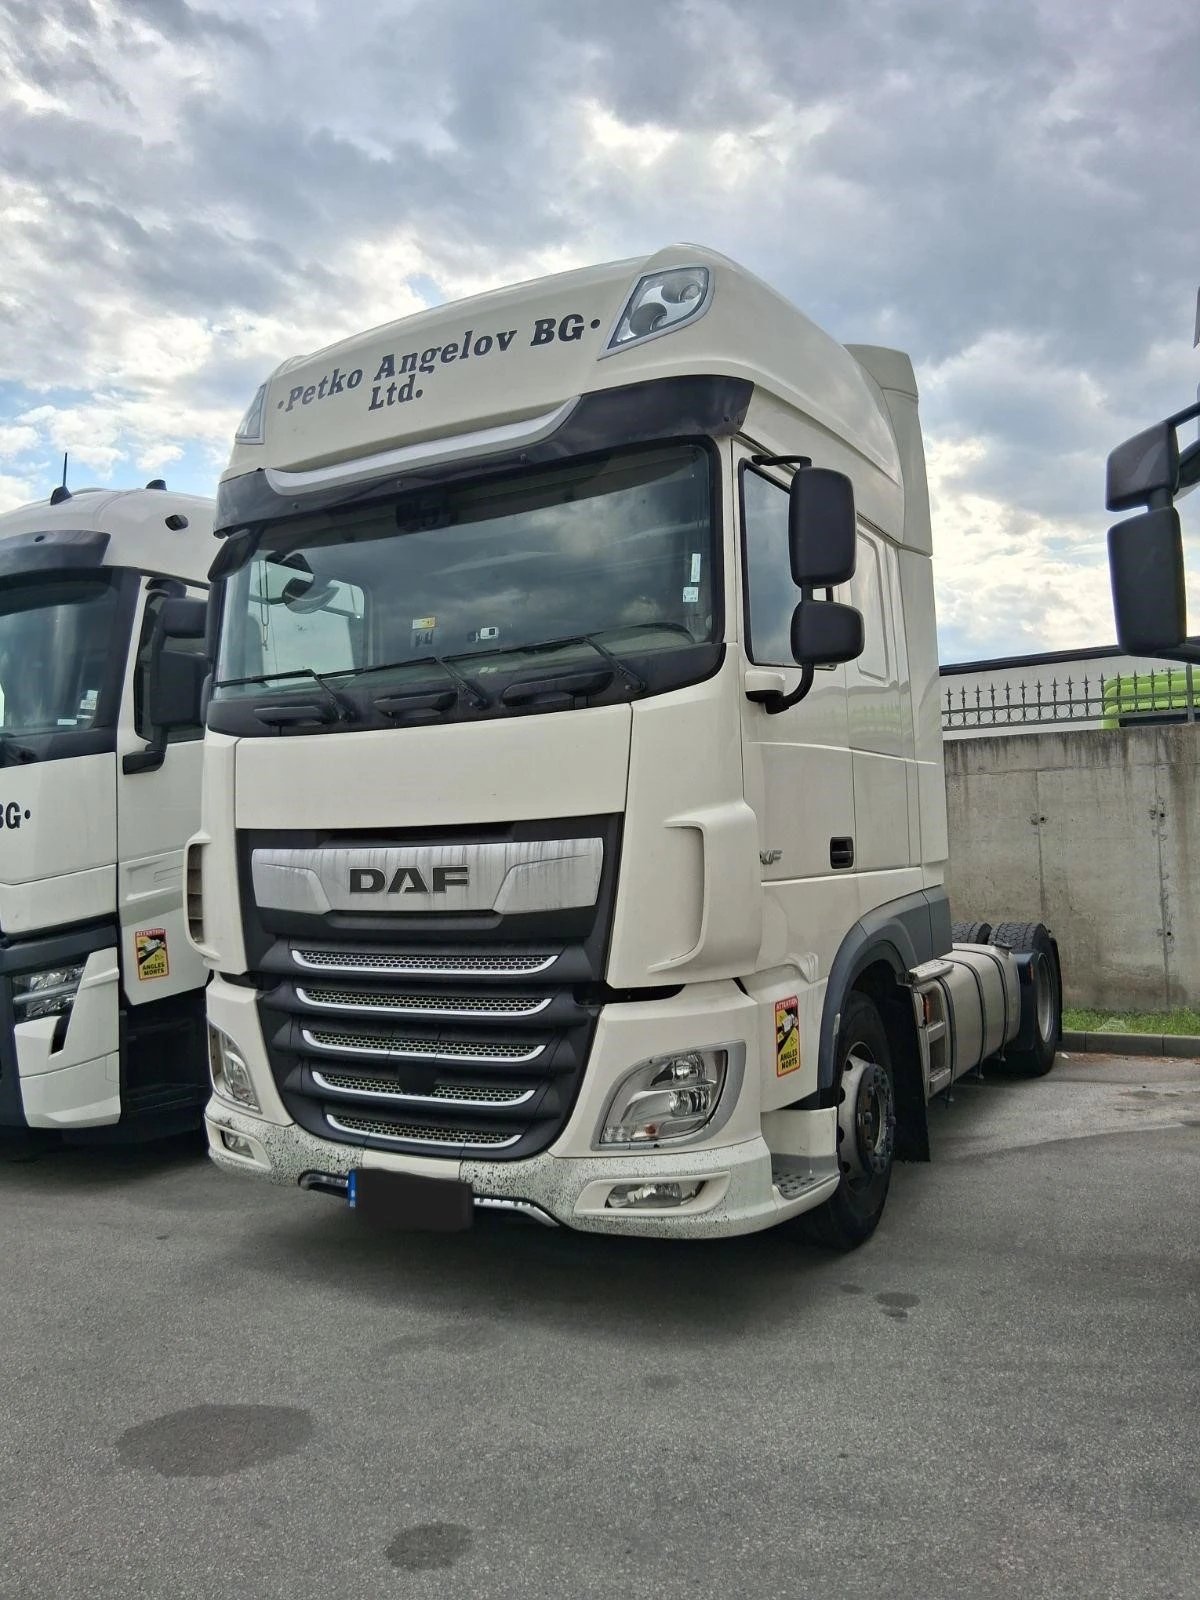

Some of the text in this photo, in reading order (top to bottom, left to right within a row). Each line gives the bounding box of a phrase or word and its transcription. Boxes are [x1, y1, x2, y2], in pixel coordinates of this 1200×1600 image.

[373, 330, 517, 381] Angelov
[349, 866, 468, 893] DAF
[142, 962, 164, 970] ANGLES
[143, 968, 164, 976] MORTS
[780, 1050, 797, 1062] ANGLES
[781, 1059, 797, 1070] MORTS
